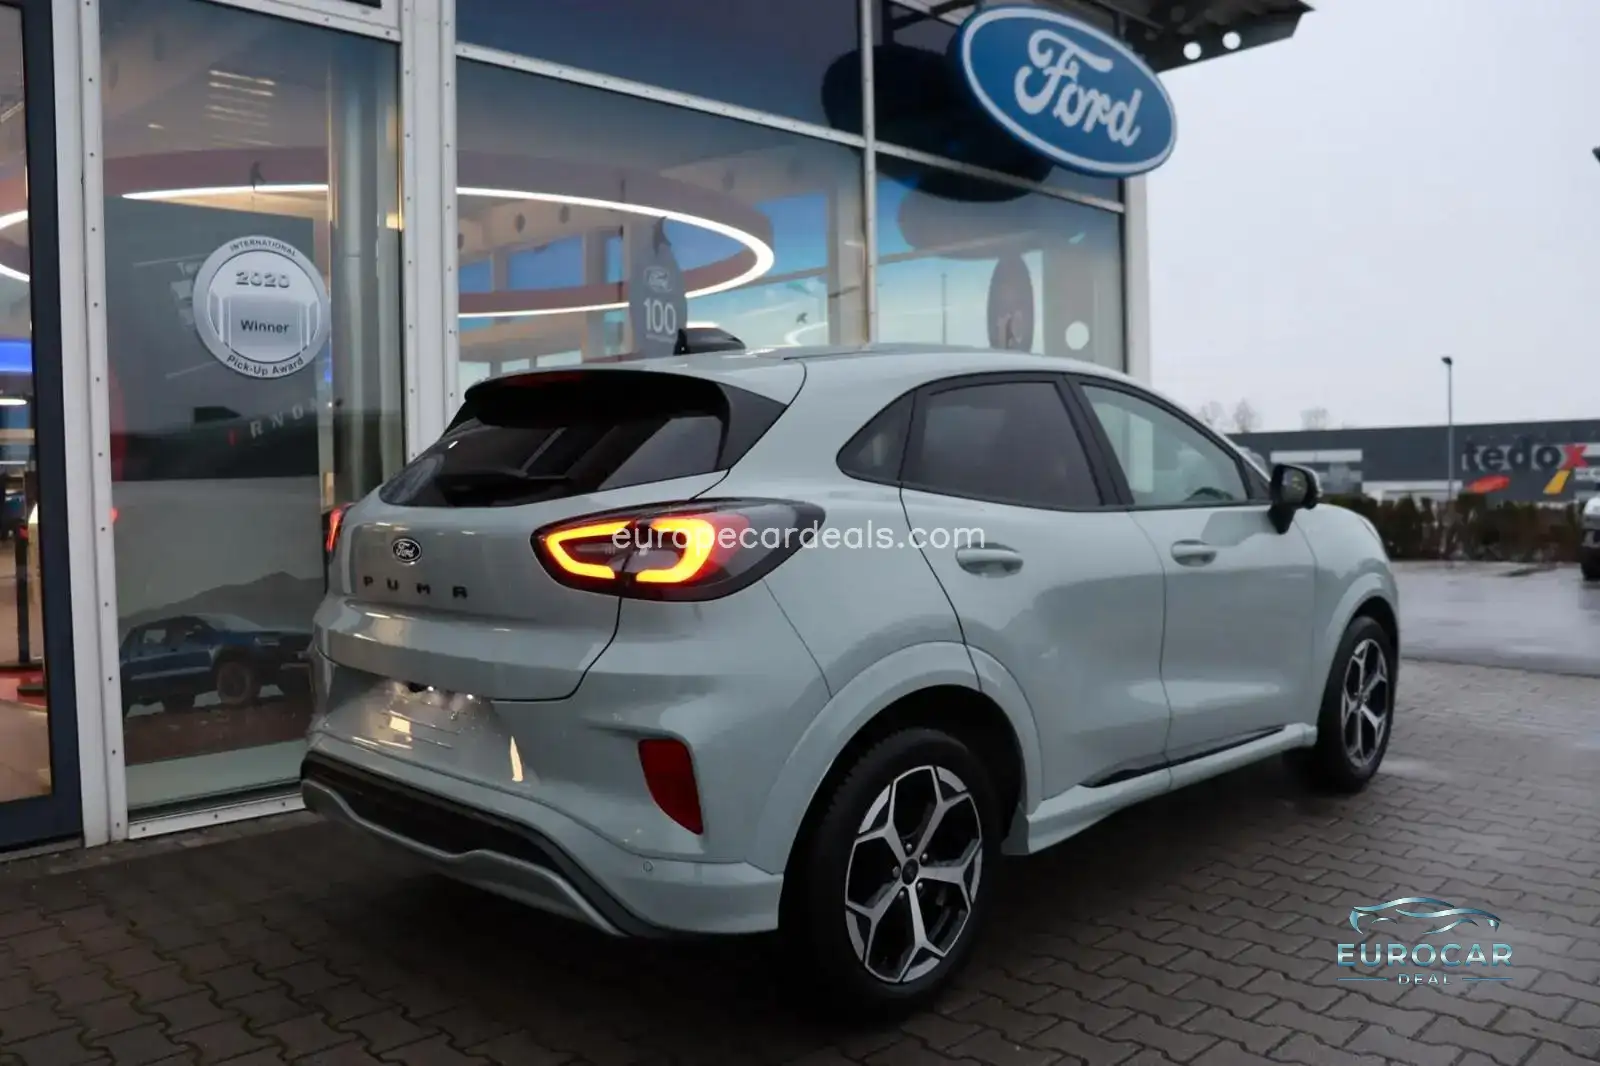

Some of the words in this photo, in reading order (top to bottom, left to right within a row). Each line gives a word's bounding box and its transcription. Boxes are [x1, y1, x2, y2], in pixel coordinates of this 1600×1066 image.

[1014, 29, 1143, 147] Ford
[229, 239, 297, 257] INTERNATIONAL
[235, 271, 290, 289] 2020
[240, 318, 290, 334] Winner
[643, 297, 677, 335] 100
[226, 354, 268, 376] Pick-Up
[272, 357, 305, 375] Award
[1461, 437, 1589, 471] tedox
[363, 575, 468, 599] PUMA
